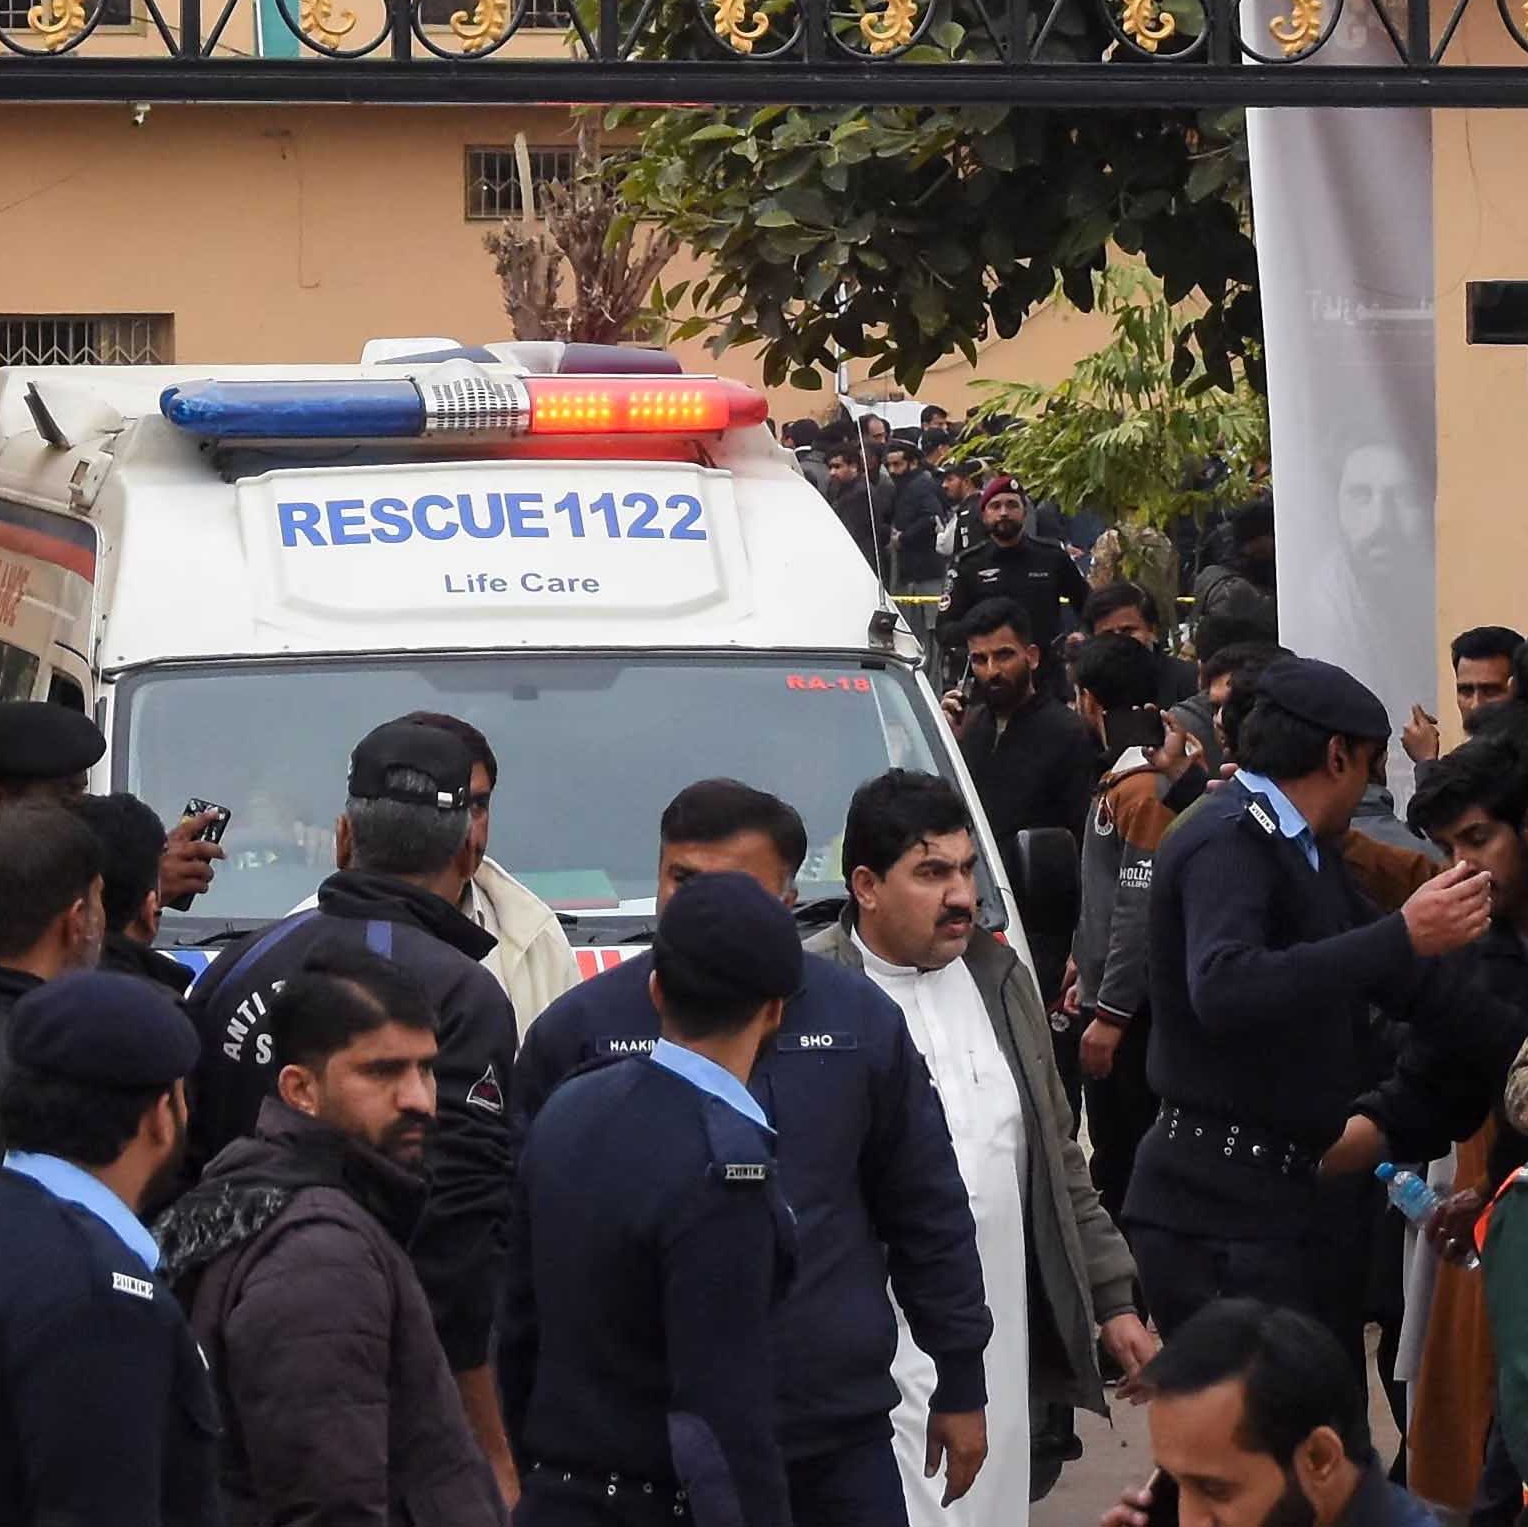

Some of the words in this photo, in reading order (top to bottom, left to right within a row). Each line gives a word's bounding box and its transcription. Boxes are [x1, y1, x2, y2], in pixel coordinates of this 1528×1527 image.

[276, 492, 550, 548] RESCUE
[554, 491, 708, 541] 1122
[444, 573, 509, 593] Life
[520, 572, 600, 593] Care
[1119, 867, 1153, 882] HOLLIS
[223, 991, 267, 1062] ANTI
[800, 1035, 833, 1047] SHO
